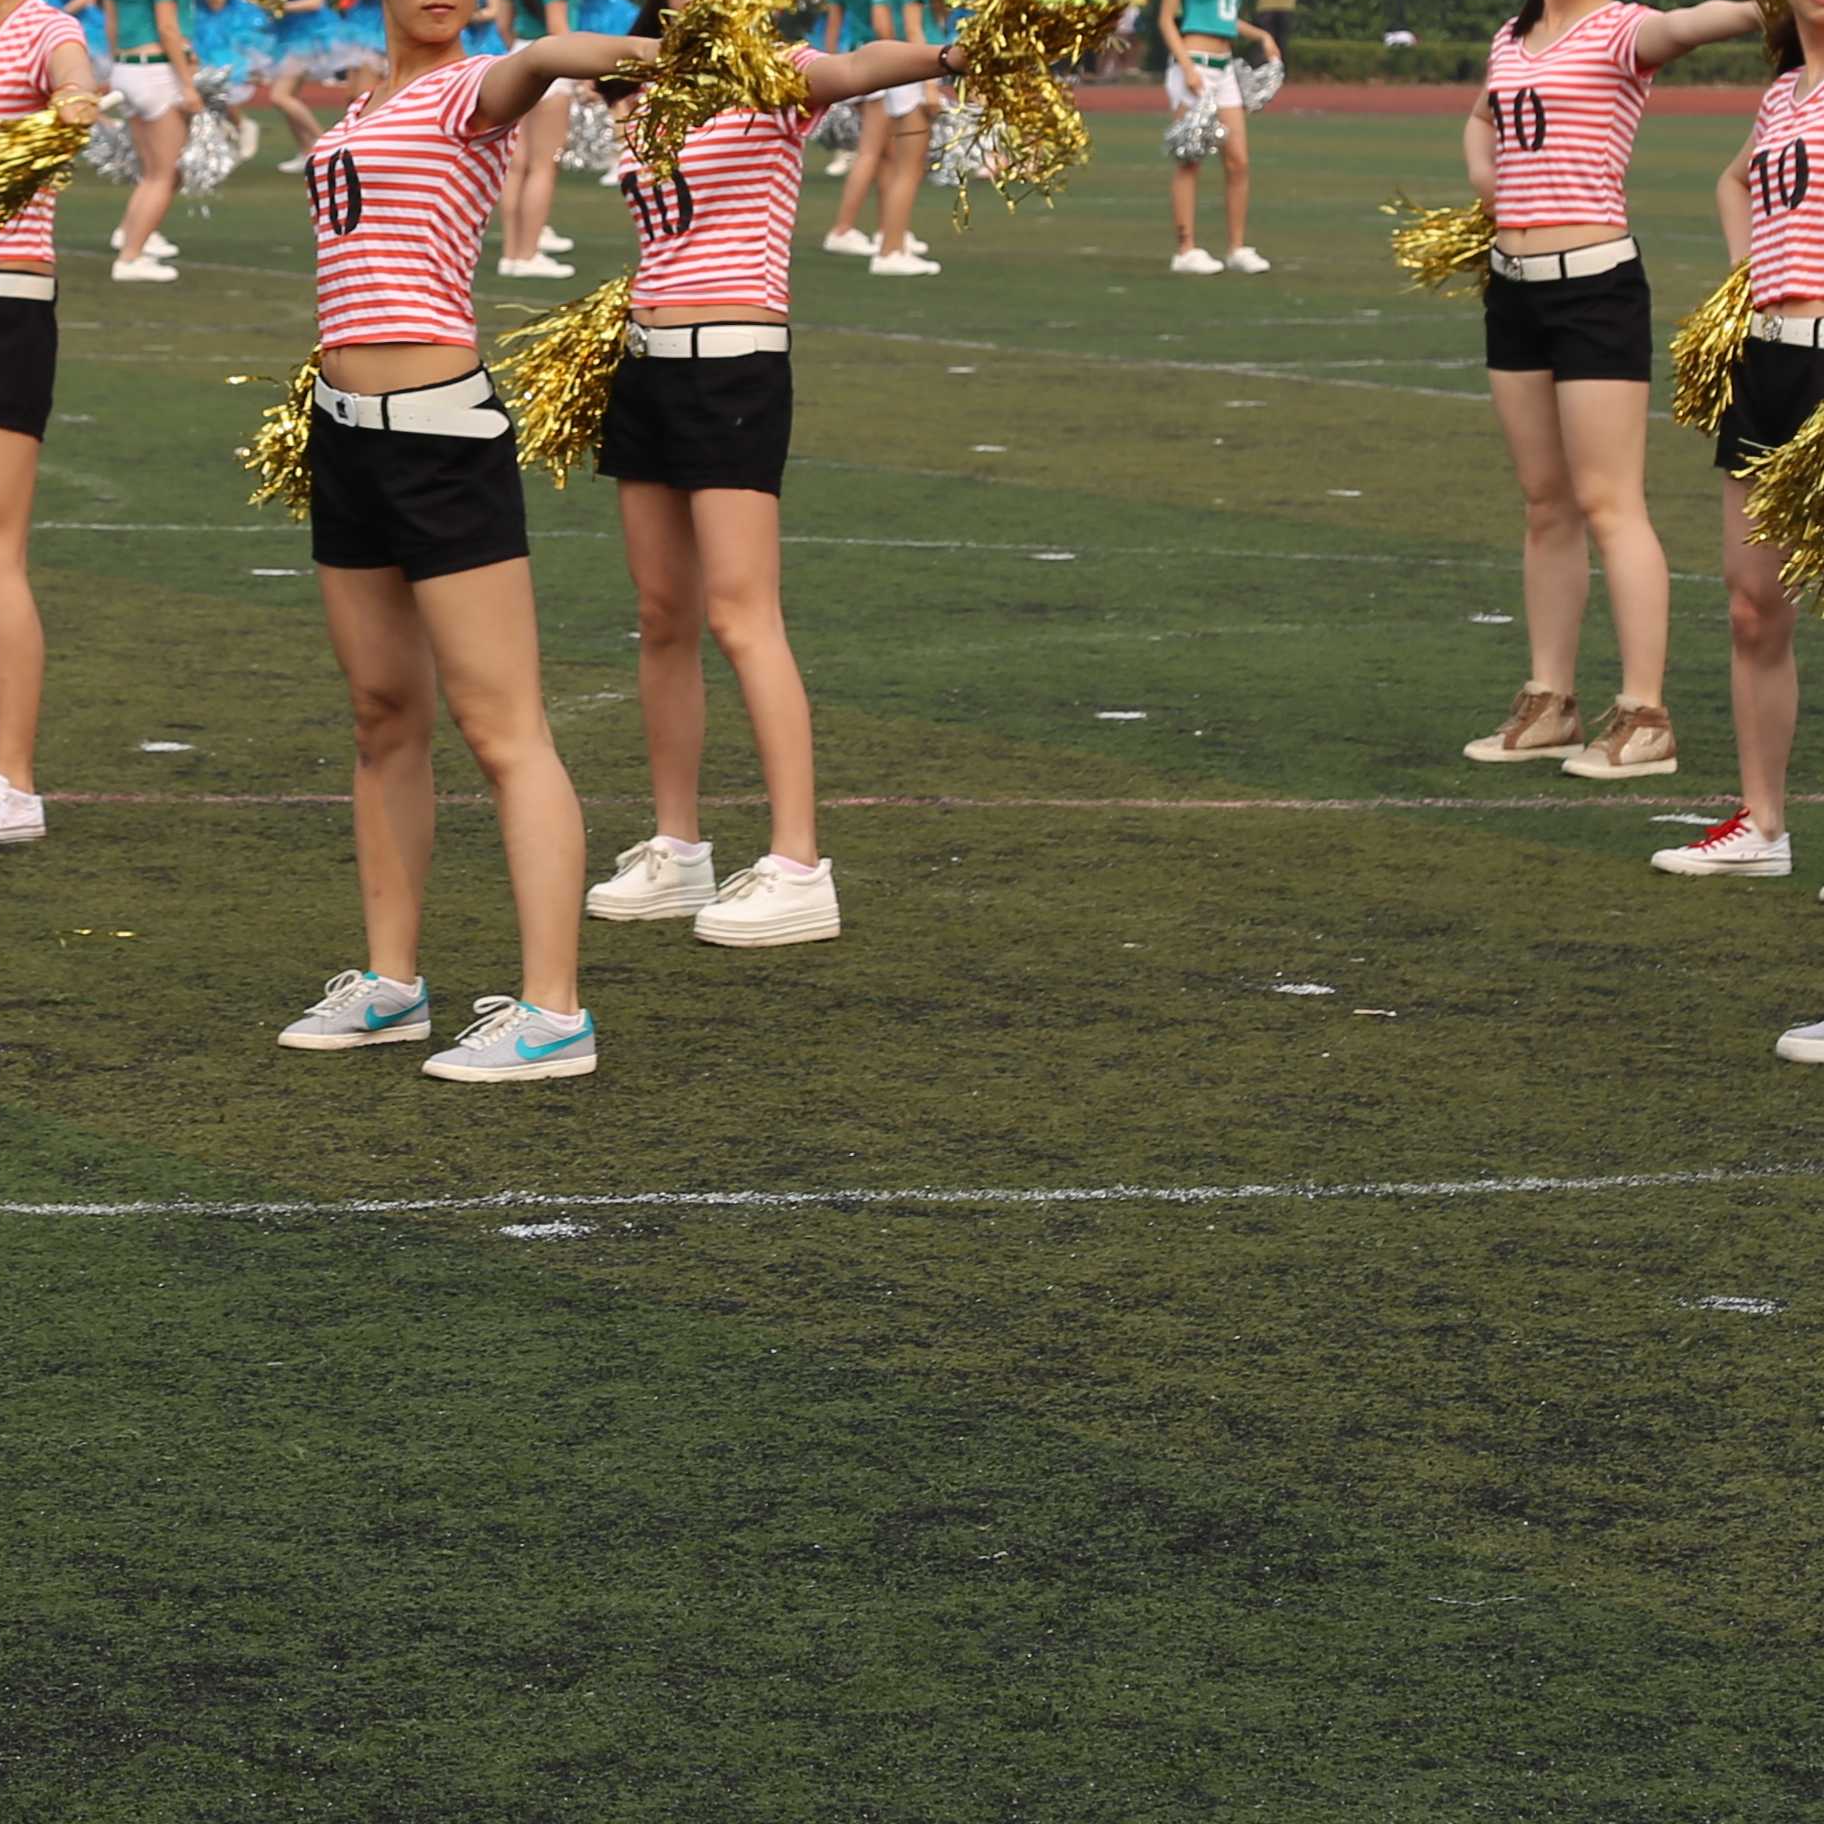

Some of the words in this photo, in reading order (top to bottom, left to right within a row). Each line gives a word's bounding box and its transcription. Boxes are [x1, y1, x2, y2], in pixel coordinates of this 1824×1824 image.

[1488, 86, 1546, 152] 10
[305, 147, 363, 235] 10
[620, 169, 694, 241] 10
[1749, 138, 1809, 216] 10
